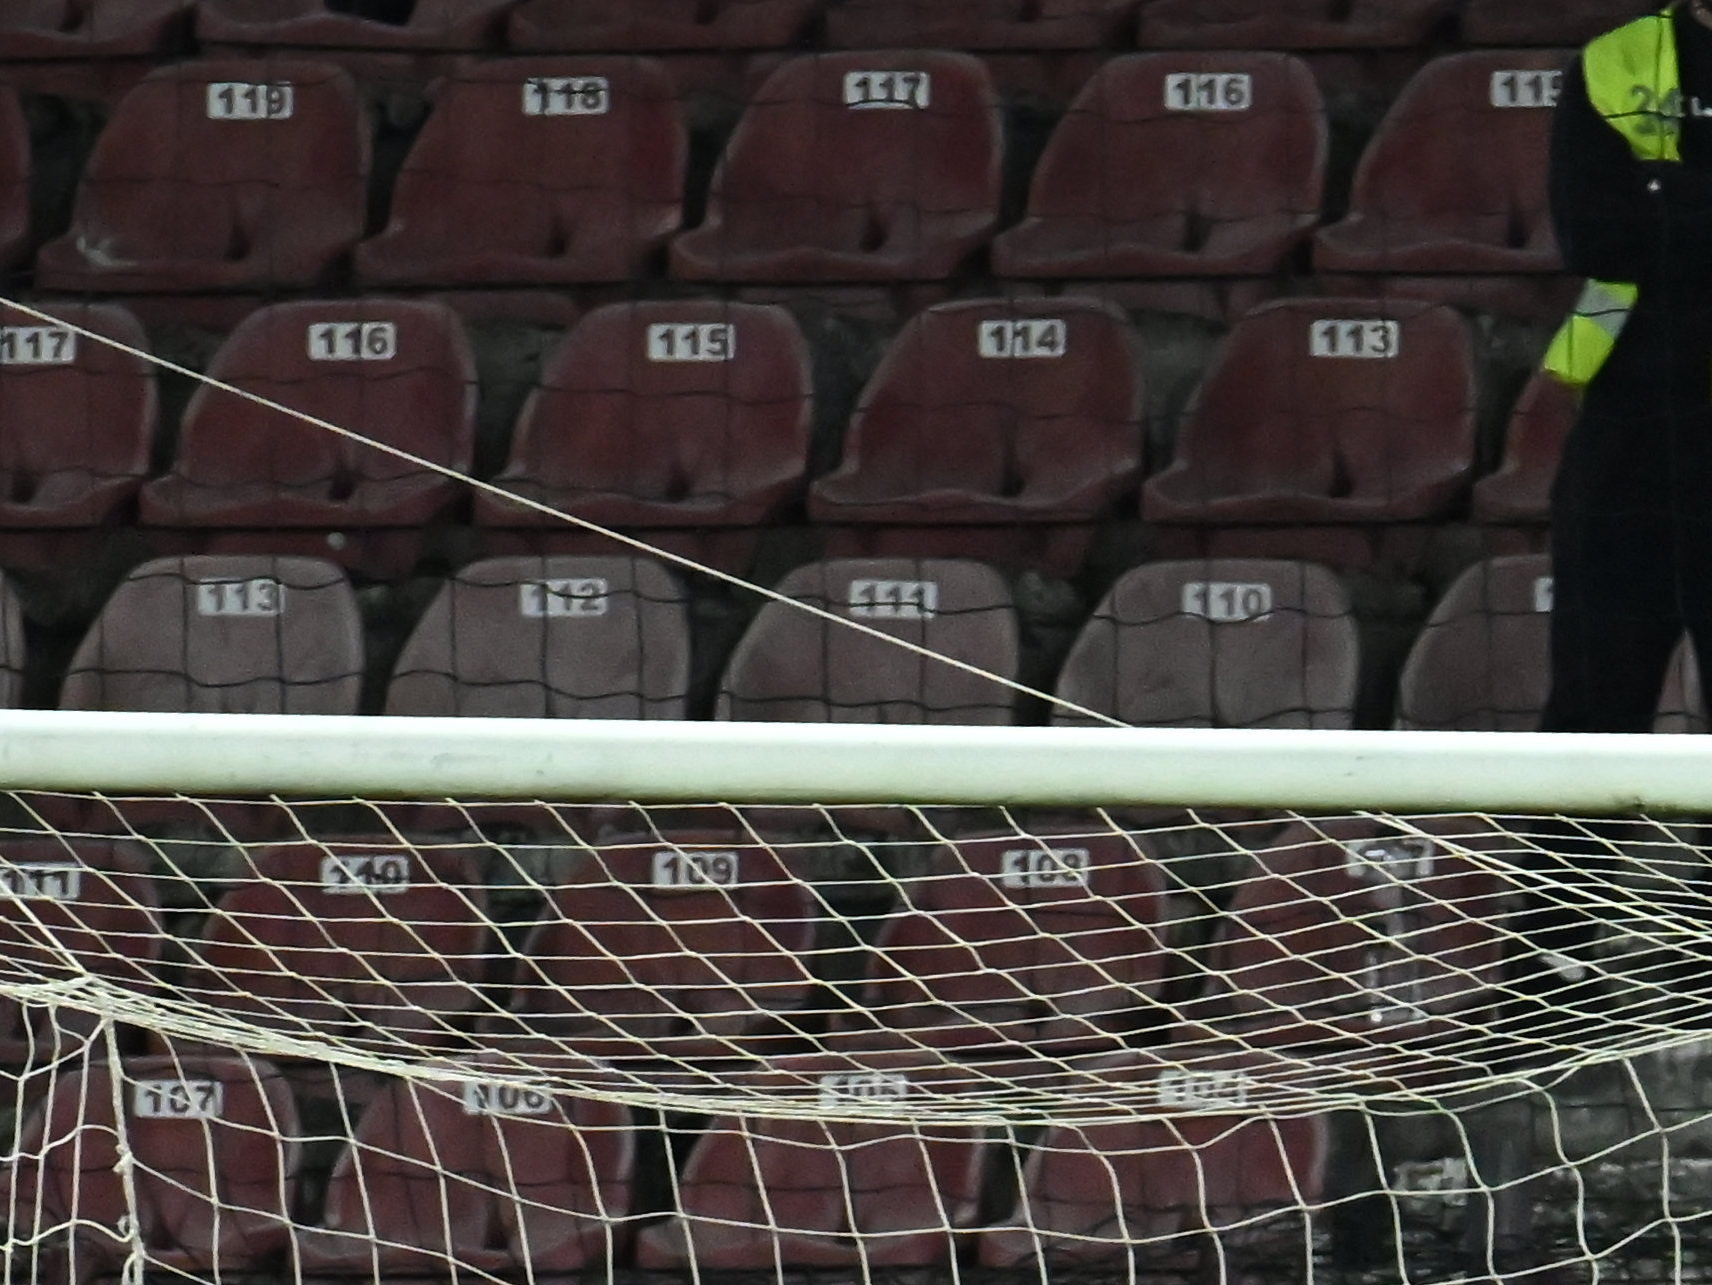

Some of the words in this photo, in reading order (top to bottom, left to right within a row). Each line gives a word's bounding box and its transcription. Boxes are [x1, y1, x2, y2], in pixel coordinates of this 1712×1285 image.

[216, 86, 285, 115] 119
[532, 81, 600, 111] 118
[854, 76, 920, 106] 117
[1172, 77, 1242, 108] 116
[318, 326, 387, 355] 116
[657, 327, 727, 356] 115
[988, 324, 1057, 354] 114
[1321, 324, 1390, 354] 113
[206, 582, 278, 612] 113
[859, 585, 925, 615] 111
[1192, 586, 1261, 616] 110
